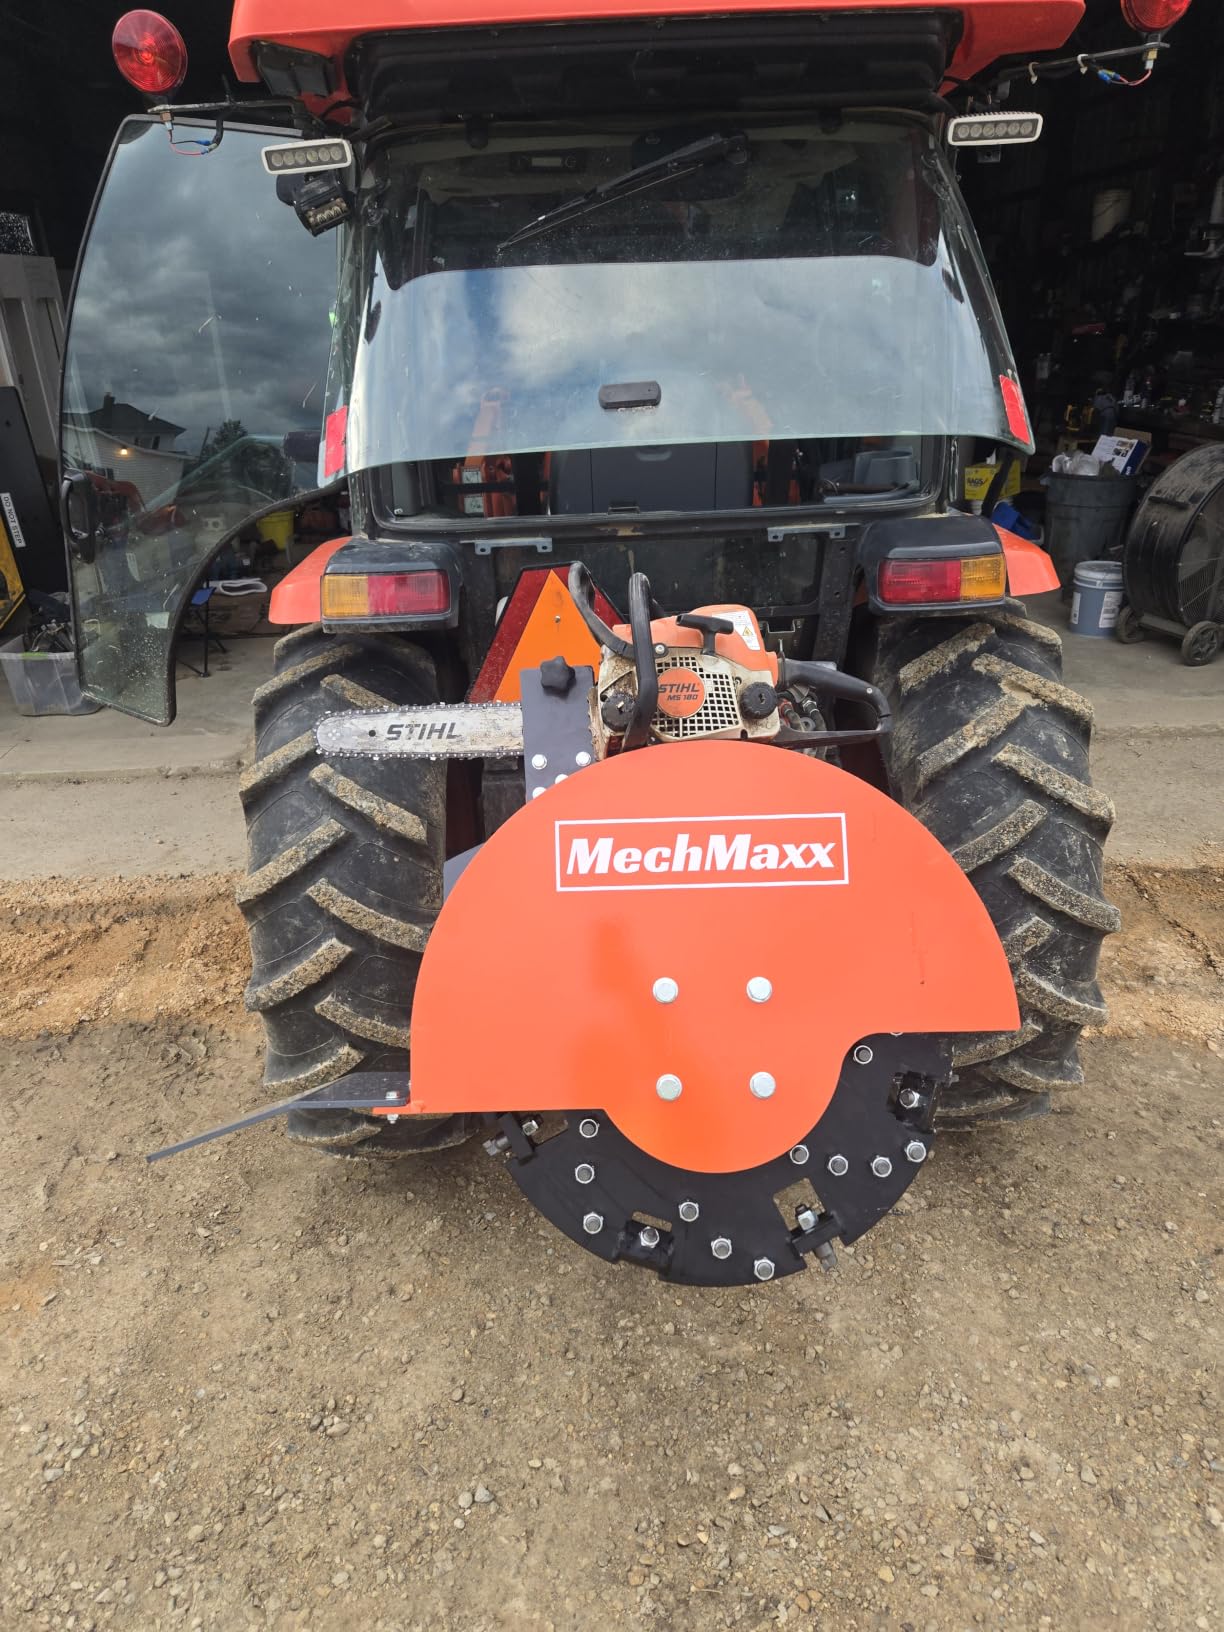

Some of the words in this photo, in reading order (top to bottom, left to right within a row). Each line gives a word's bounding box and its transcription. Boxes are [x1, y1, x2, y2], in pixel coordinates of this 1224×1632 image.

[4, 496, 10, 507] DO
[8, 508, 16, 524] NOT
[12, 525, 22, 544] STEP
[658, 683, 700, 693] STIHL
[385, 722, 462, 741] STIHL
[566, 833, 836, 875] MechMaxx
